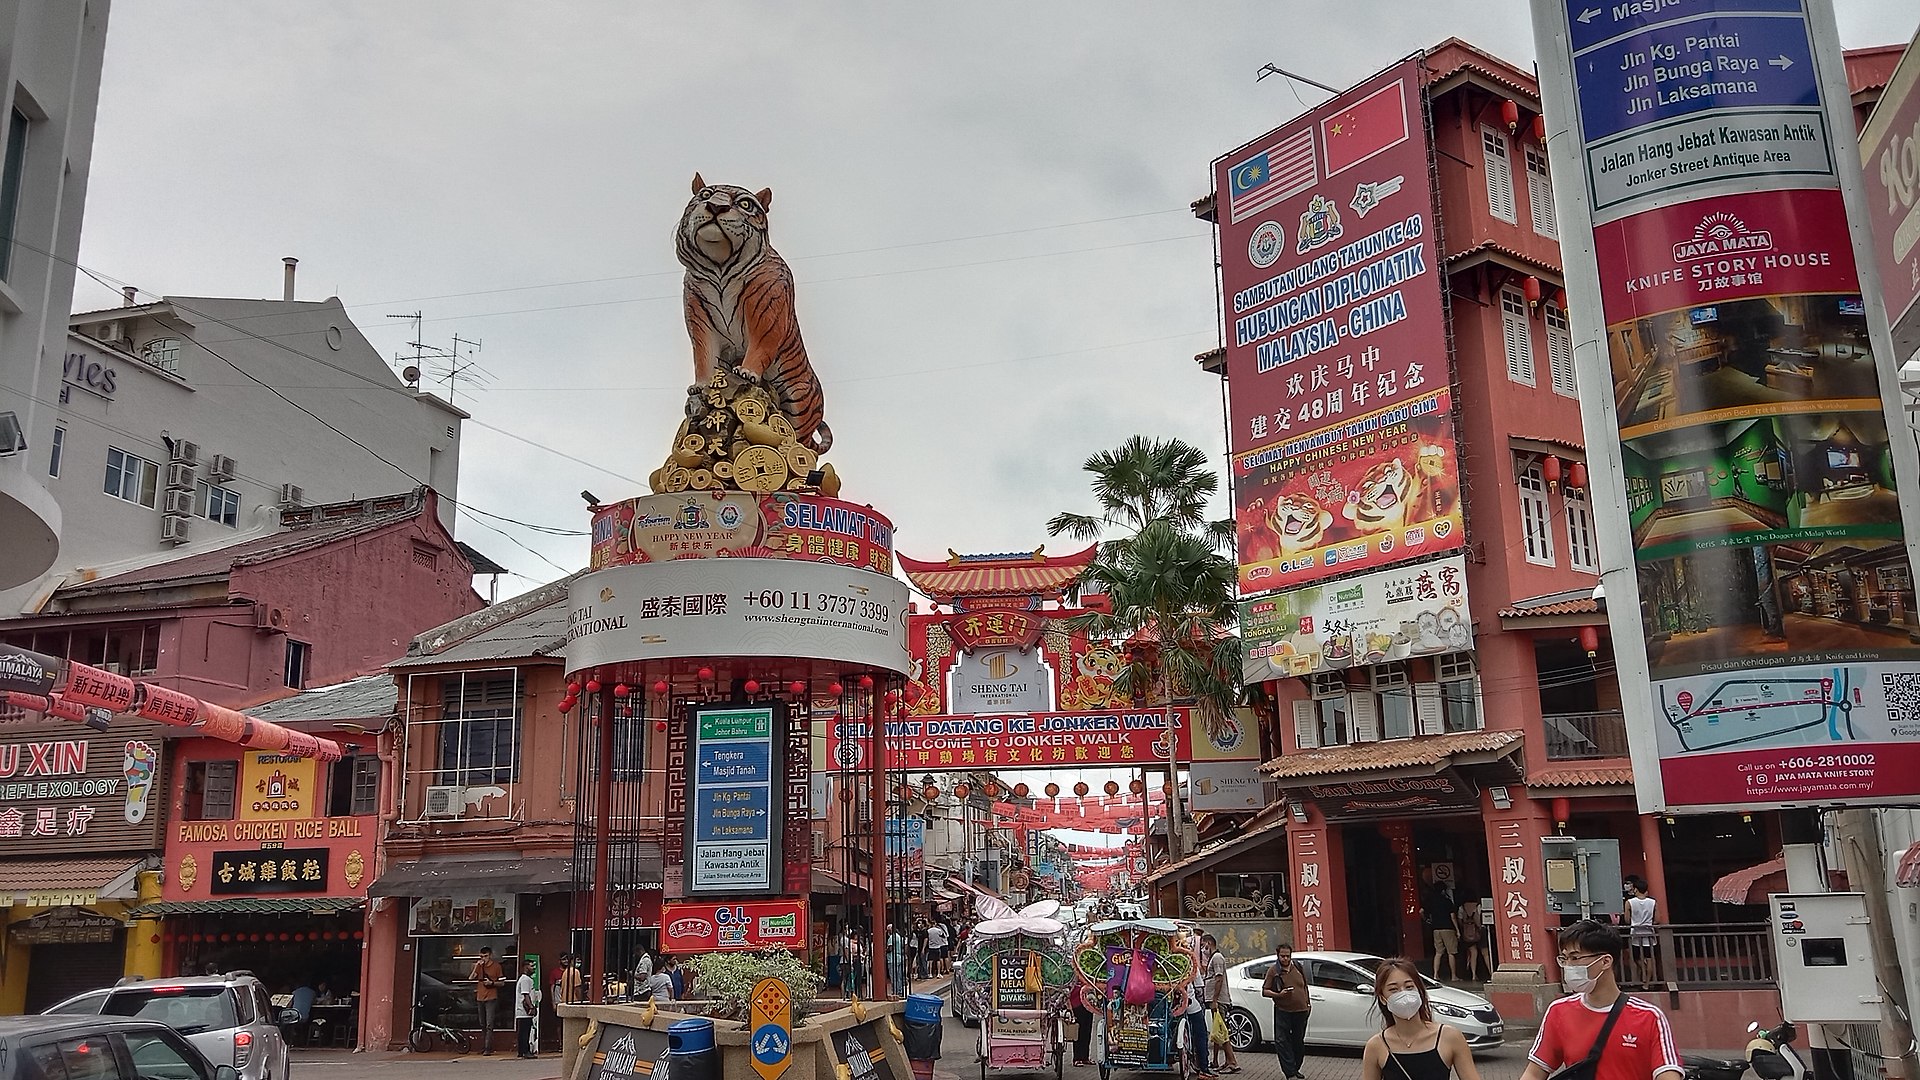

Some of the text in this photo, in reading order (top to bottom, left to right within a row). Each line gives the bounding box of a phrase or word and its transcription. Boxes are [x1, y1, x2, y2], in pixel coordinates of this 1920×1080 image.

[1620, 33, 1739, 72] Jln Kg. Pantai
[1624, 55, 1759, 93] Jln Bunga Raya
[1627, 79, 1757, 116] Jln Laksamana
[1600, 124, 1816, 174] Jalan Hang Jebat Kawasan Antik
[1626, 150, 1790, 187] Jonker Street Antique Area
[1676, 235, 1770, 258] JAYA MATA
[1235, 216, 1421, 313] SAMBUTAN ULANG TAHUN KE 48
[1626, 253, 1831, 293] KNIFE STORY HOUSE
[1237, 245, 1426, 347] HUBUNGAN DIPLOMATIK
[1258, 318, 1339, 373] MALAYSIA
[1350, 291, 1407, 338] CHINA
[1287, 345, 1379, 400] 欢庆马中
[1244, 398, 1437, 469] SELAMAT MENYAMBUT TAHUN BARU CINA
[1270, 424, 1407, 474] HAPPY CHINESE NEW YEAR
[784, 502, 866, 538] SELAMAT
[653, 533, 679, 542] HAPPY
[579, 606, 593, 620] TAI
[641, 593, 728, 619] 盛泰國際
[744, 589, 889, 623] +60 11 3737 3399
[744, 613, 889, 636] www.shengtaiinternational.com
[1244, 626, 1274, 638] TONGKAT
[1701, 657, 1784, 671] Pisau dan Kehidupan
[971, 683, 1028, 693] SHENG TAI
[731, 727, 748, 735] Bahru
[927, 714, 1182, 736] DATANG KE JONKER WALK
[885, 732, 1131, 750] WELCOME TO JONKER WALK
[24, 741, 89, 776] XIN
[714, 751, 744, 761] Tengkera
[1779, 754, 1875, 769] +606-2810002
[713, 765, 755, 778] Masjid Tanah
[1775, 774, 1796, 782] JAYA
[1798, 771, 1822, 779] MATA
[1824, 770, 1847, 778] KNIFE
[713, 793, 722, 802] Jln
[733, 791, 751, 801] Pantai
[1309, 777, 1455, 798] San Shu Gong
[712, 809, 755, 819] Jln Bunga Raya
[179, 820, 361, 842] FAMOSA CHICKEN RICE BALL
[712, 826, 753, 836] Jln Laksamana
[700, 849, 765, 859] Jalan Hang Jebat
[704, 859, 760, 869] Kawasan Antik
[1298, 833, 1321, 918] 三叔公
[1499, 823, 1528, 918] 三叔公
[715, 907, 752, 925] G.L.
[1000, 968, 1024, 979] BEC
